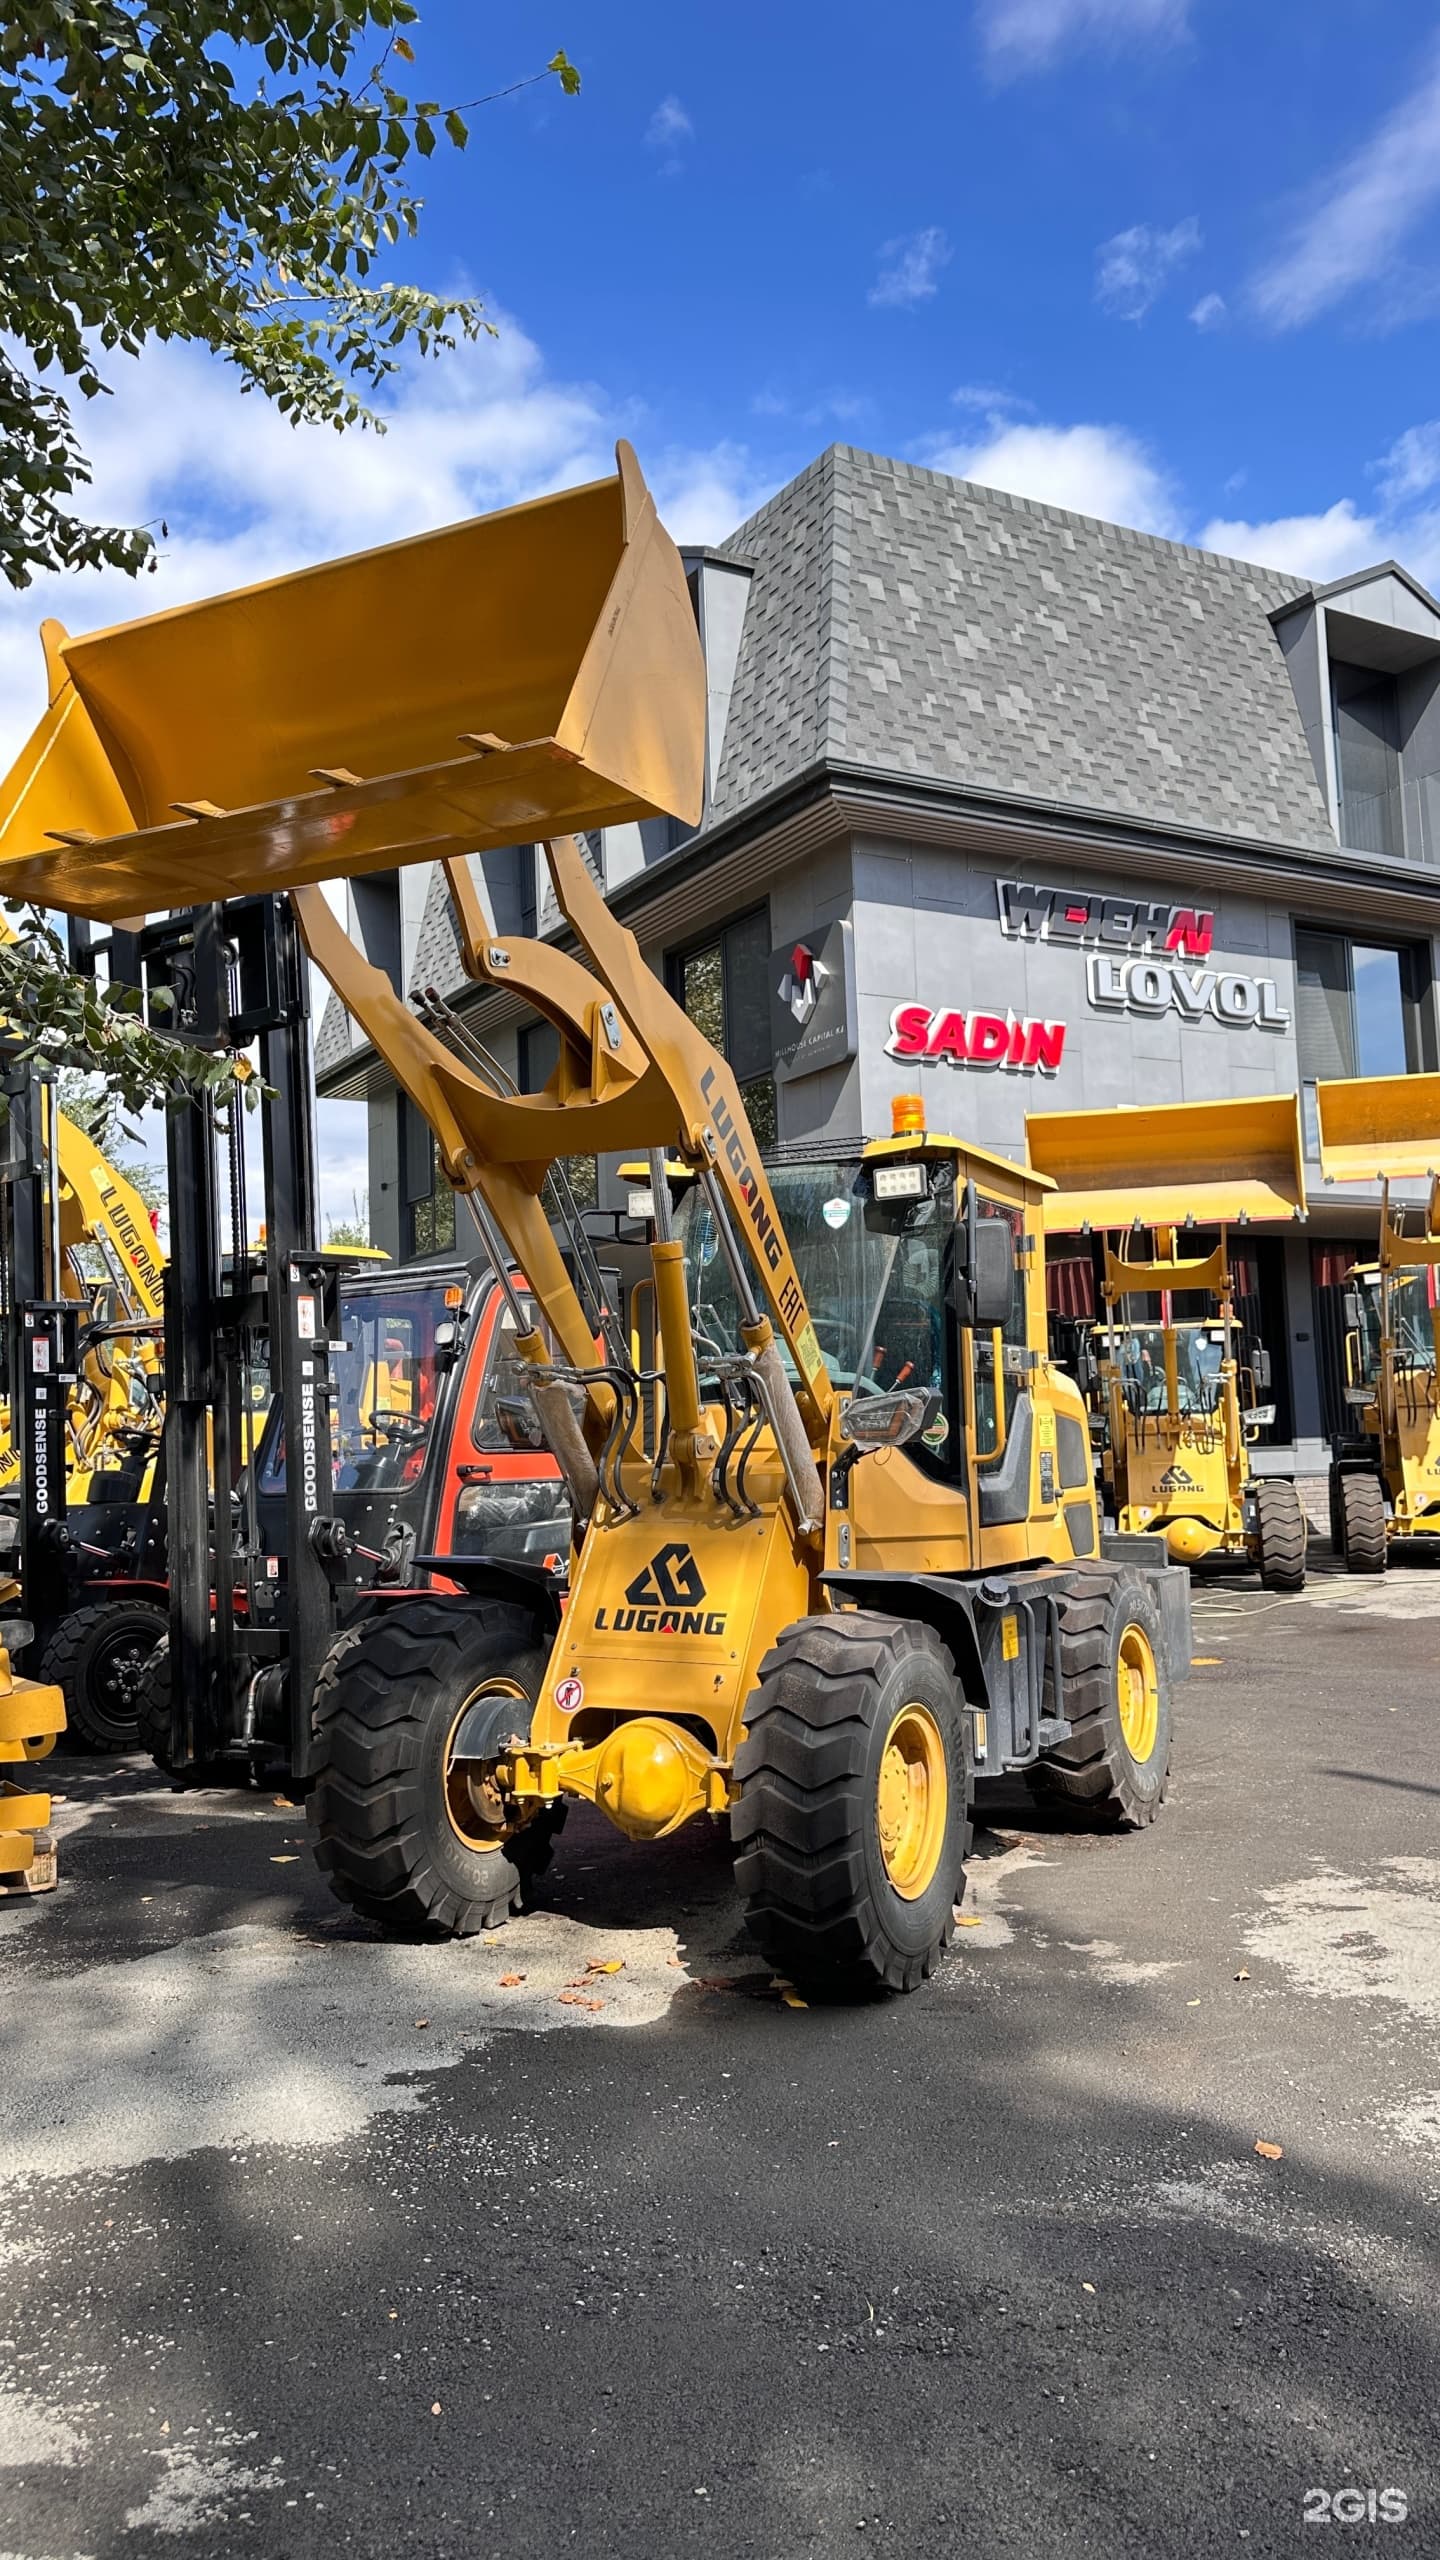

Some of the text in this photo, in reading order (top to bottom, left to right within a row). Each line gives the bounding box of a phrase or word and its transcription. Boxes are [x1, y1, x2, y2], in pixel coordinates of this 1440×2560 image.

[1089, 955, 1290, 1026] LOVOL
[808, 1029, 834, 1046] CAPITAL
[888, 1004, 1067, 1073] SADIN
[701, 1066, 783, 1272] LUGONG
[35, 1408, 48, 1514] GOODSENSE
[302, 1383, 317, 1511] GOODSENSE
[1151, 1485, 1204, 1493] LUGONG
[594, 1607, 728, 1636] LUGONG
